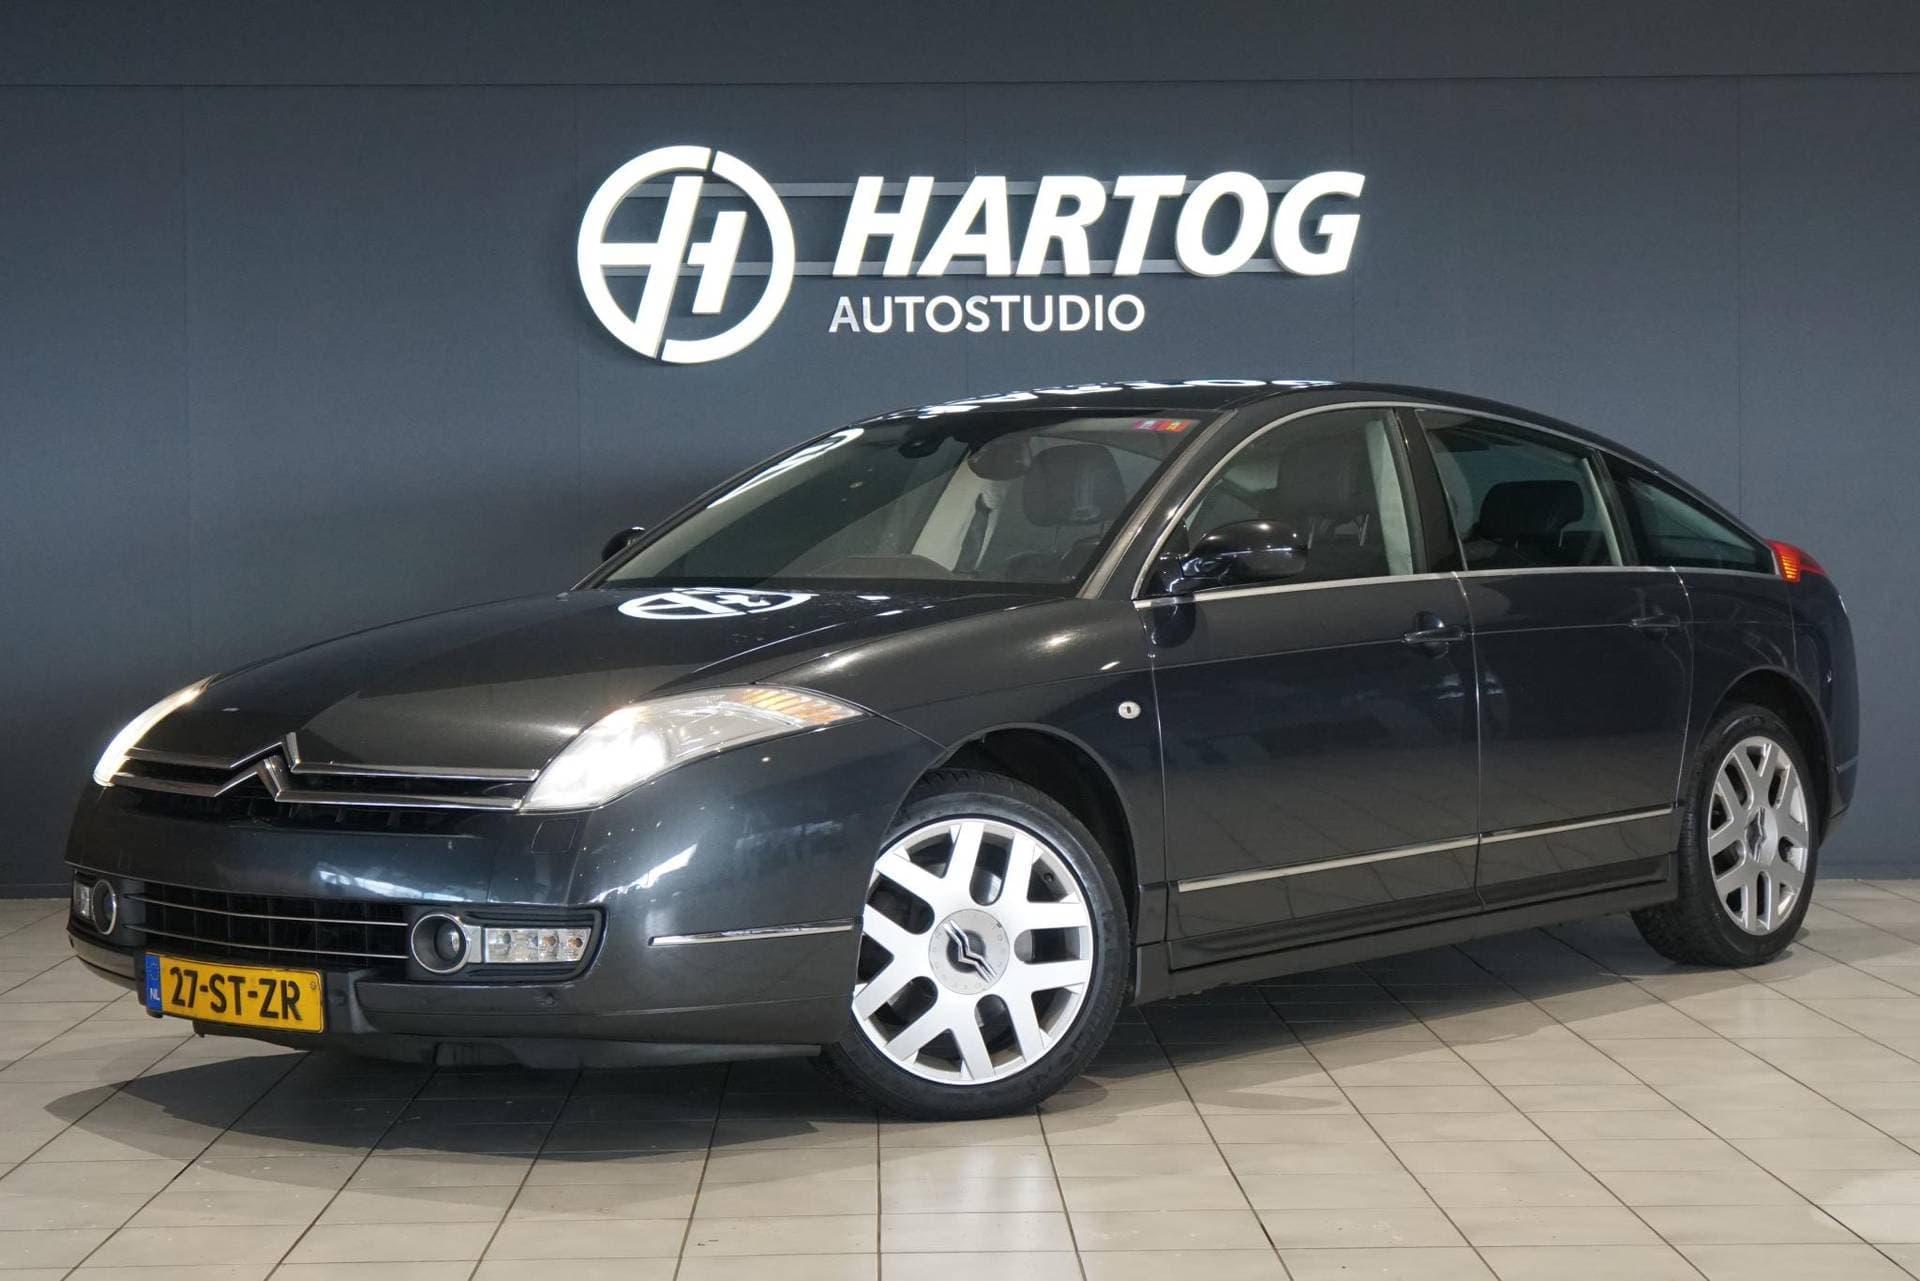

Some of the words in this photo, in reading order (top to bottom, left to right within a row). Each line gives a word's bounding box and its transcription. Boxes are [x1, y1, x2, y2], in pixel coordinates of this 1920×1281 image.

[833, 172, 1366, 276] HARTOG
[829, 294, 1146, 333] AUTOSTUDIO
[149, 987, 161, 1001] NL
[169, 966, 303, 1021] 27-ST-ZR
